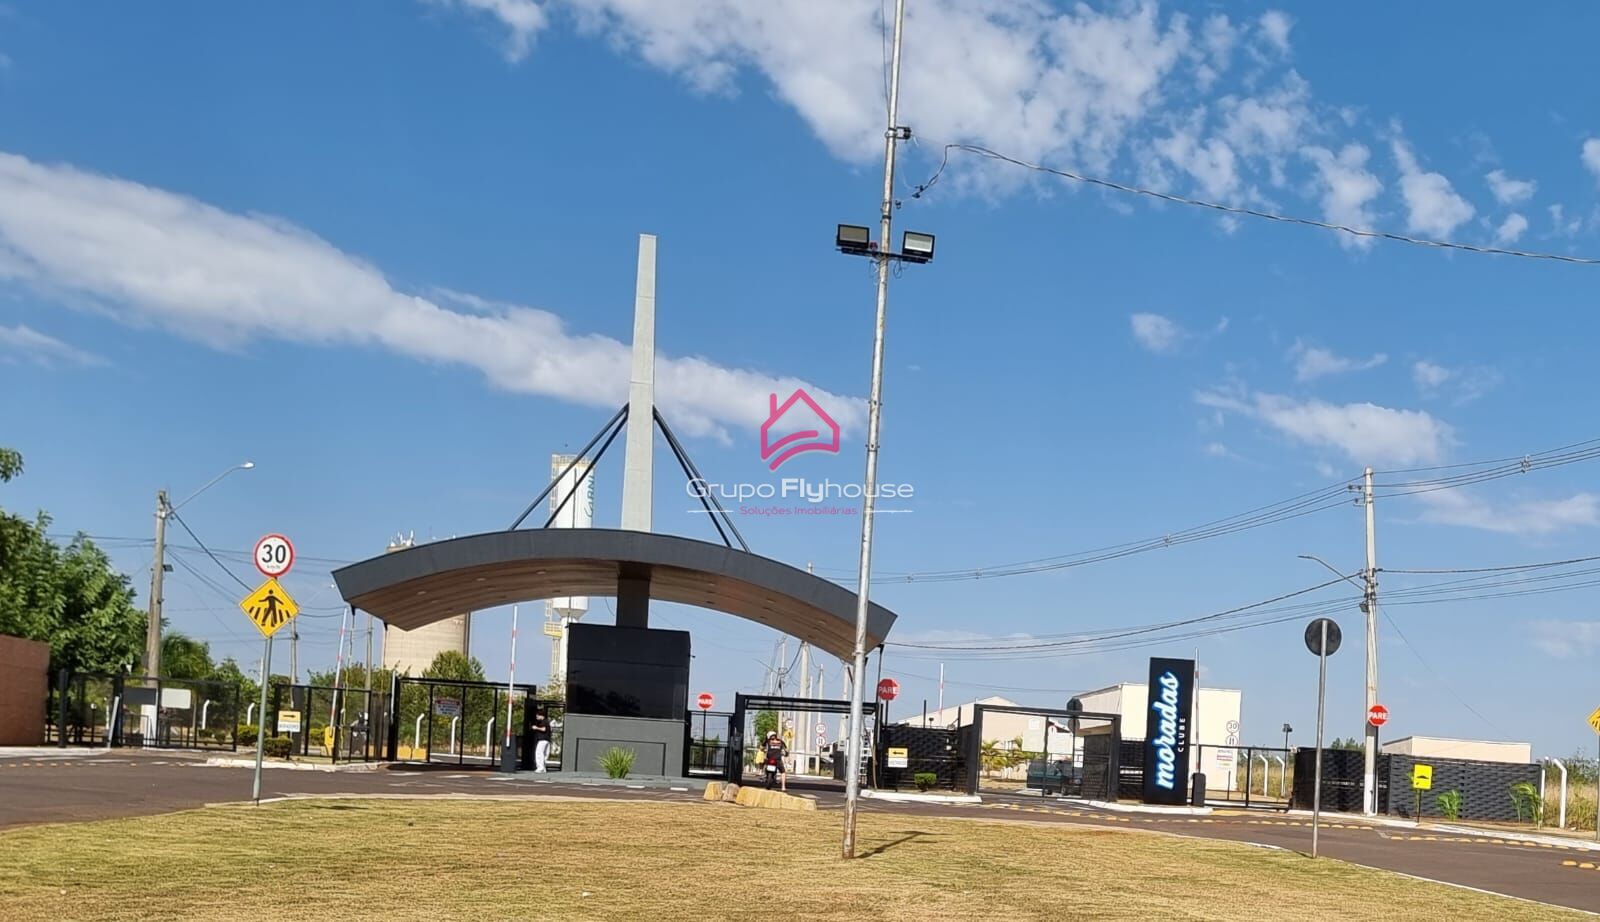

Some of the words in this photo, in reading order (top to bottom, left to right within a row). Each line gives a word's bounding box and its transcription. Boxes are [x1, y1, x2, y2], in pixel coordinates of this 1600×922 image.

[262, 544, 286, 563] 30
[879, 686, 898, 695] PARE
[1367, 712, 1389, 720] PARE
[1153, 671, 1178, 789] moradas
[1228, 722, 1238, 730] 30
[1177, 717, 1186, 752] CLUBE
